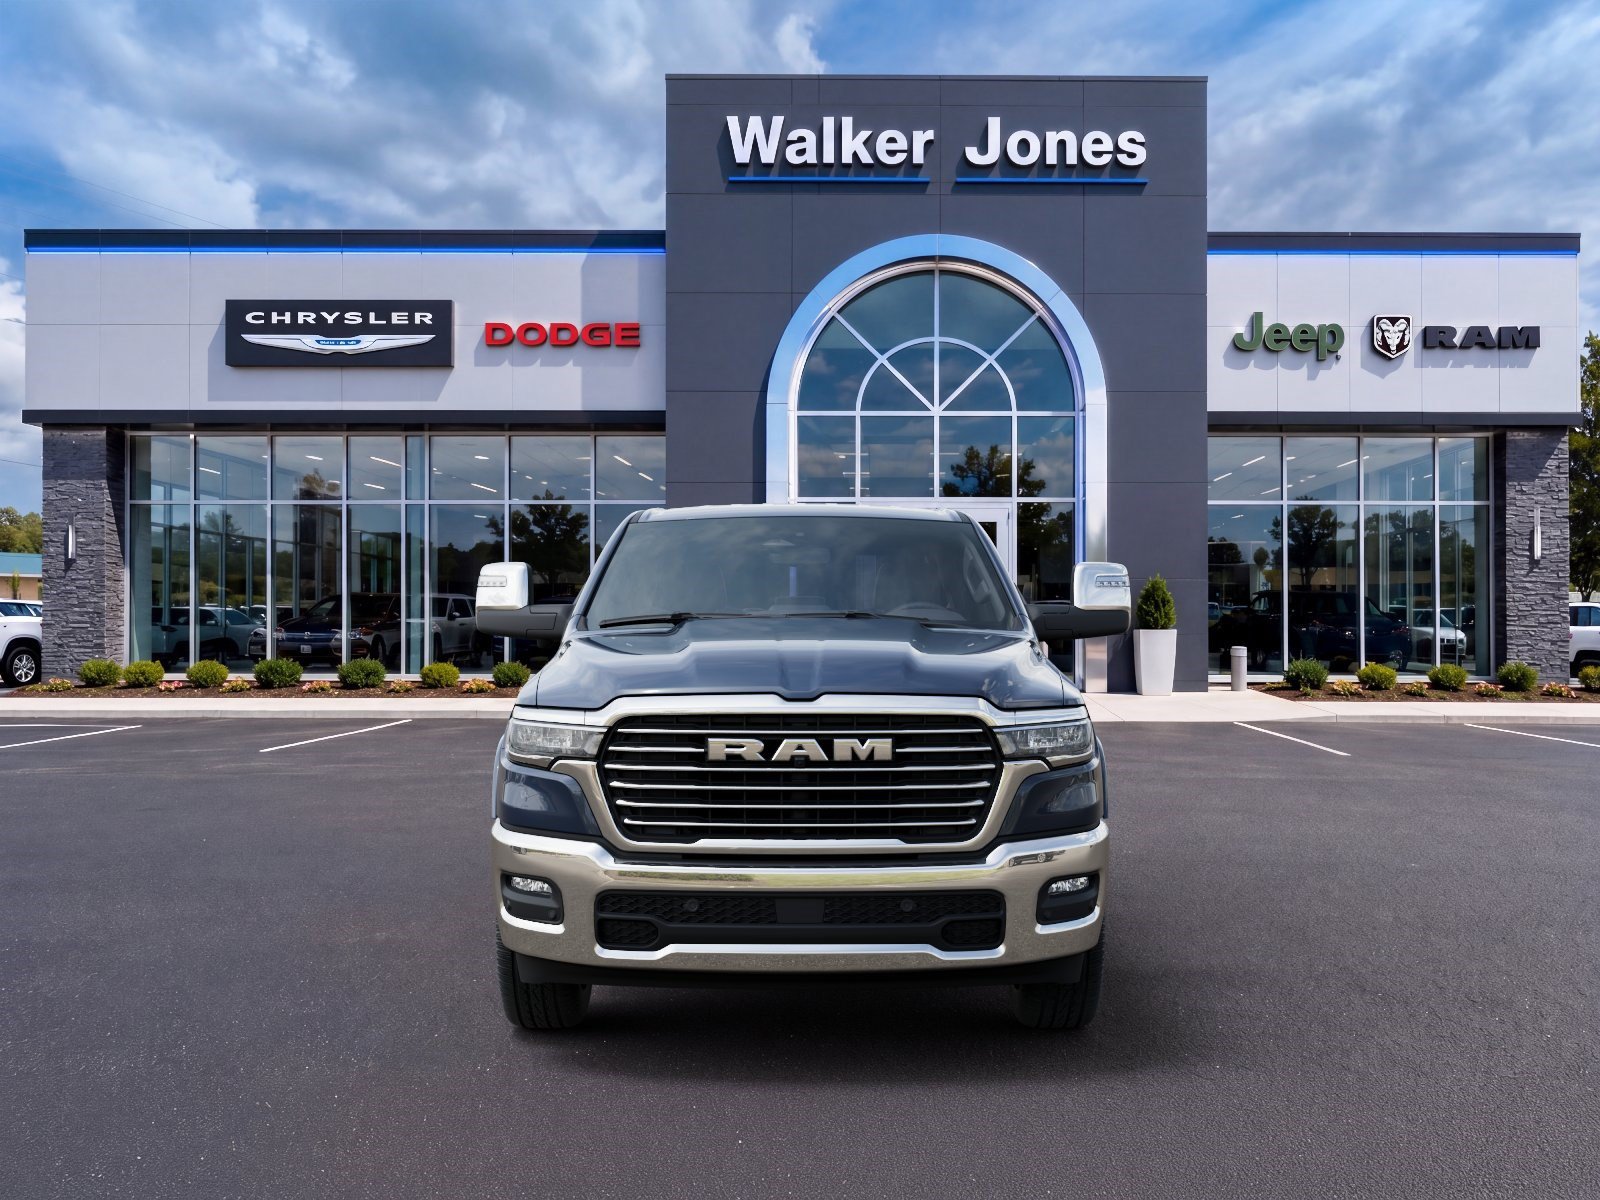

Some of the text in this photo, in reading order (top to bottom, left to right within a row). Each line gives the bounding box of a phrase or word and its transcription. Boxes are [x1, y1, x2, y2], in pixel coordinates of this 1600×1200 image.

[726, 115, 1147, 166] Walker Jones
[245, 311, 433, 325] CHRYSLER
[485, 322, 640, 347] DODGE
[1233, 311, 1345, 361] Jeep
[1423, 325, 1541, 348] RAM
[707, 737, 893, 761] RAM
